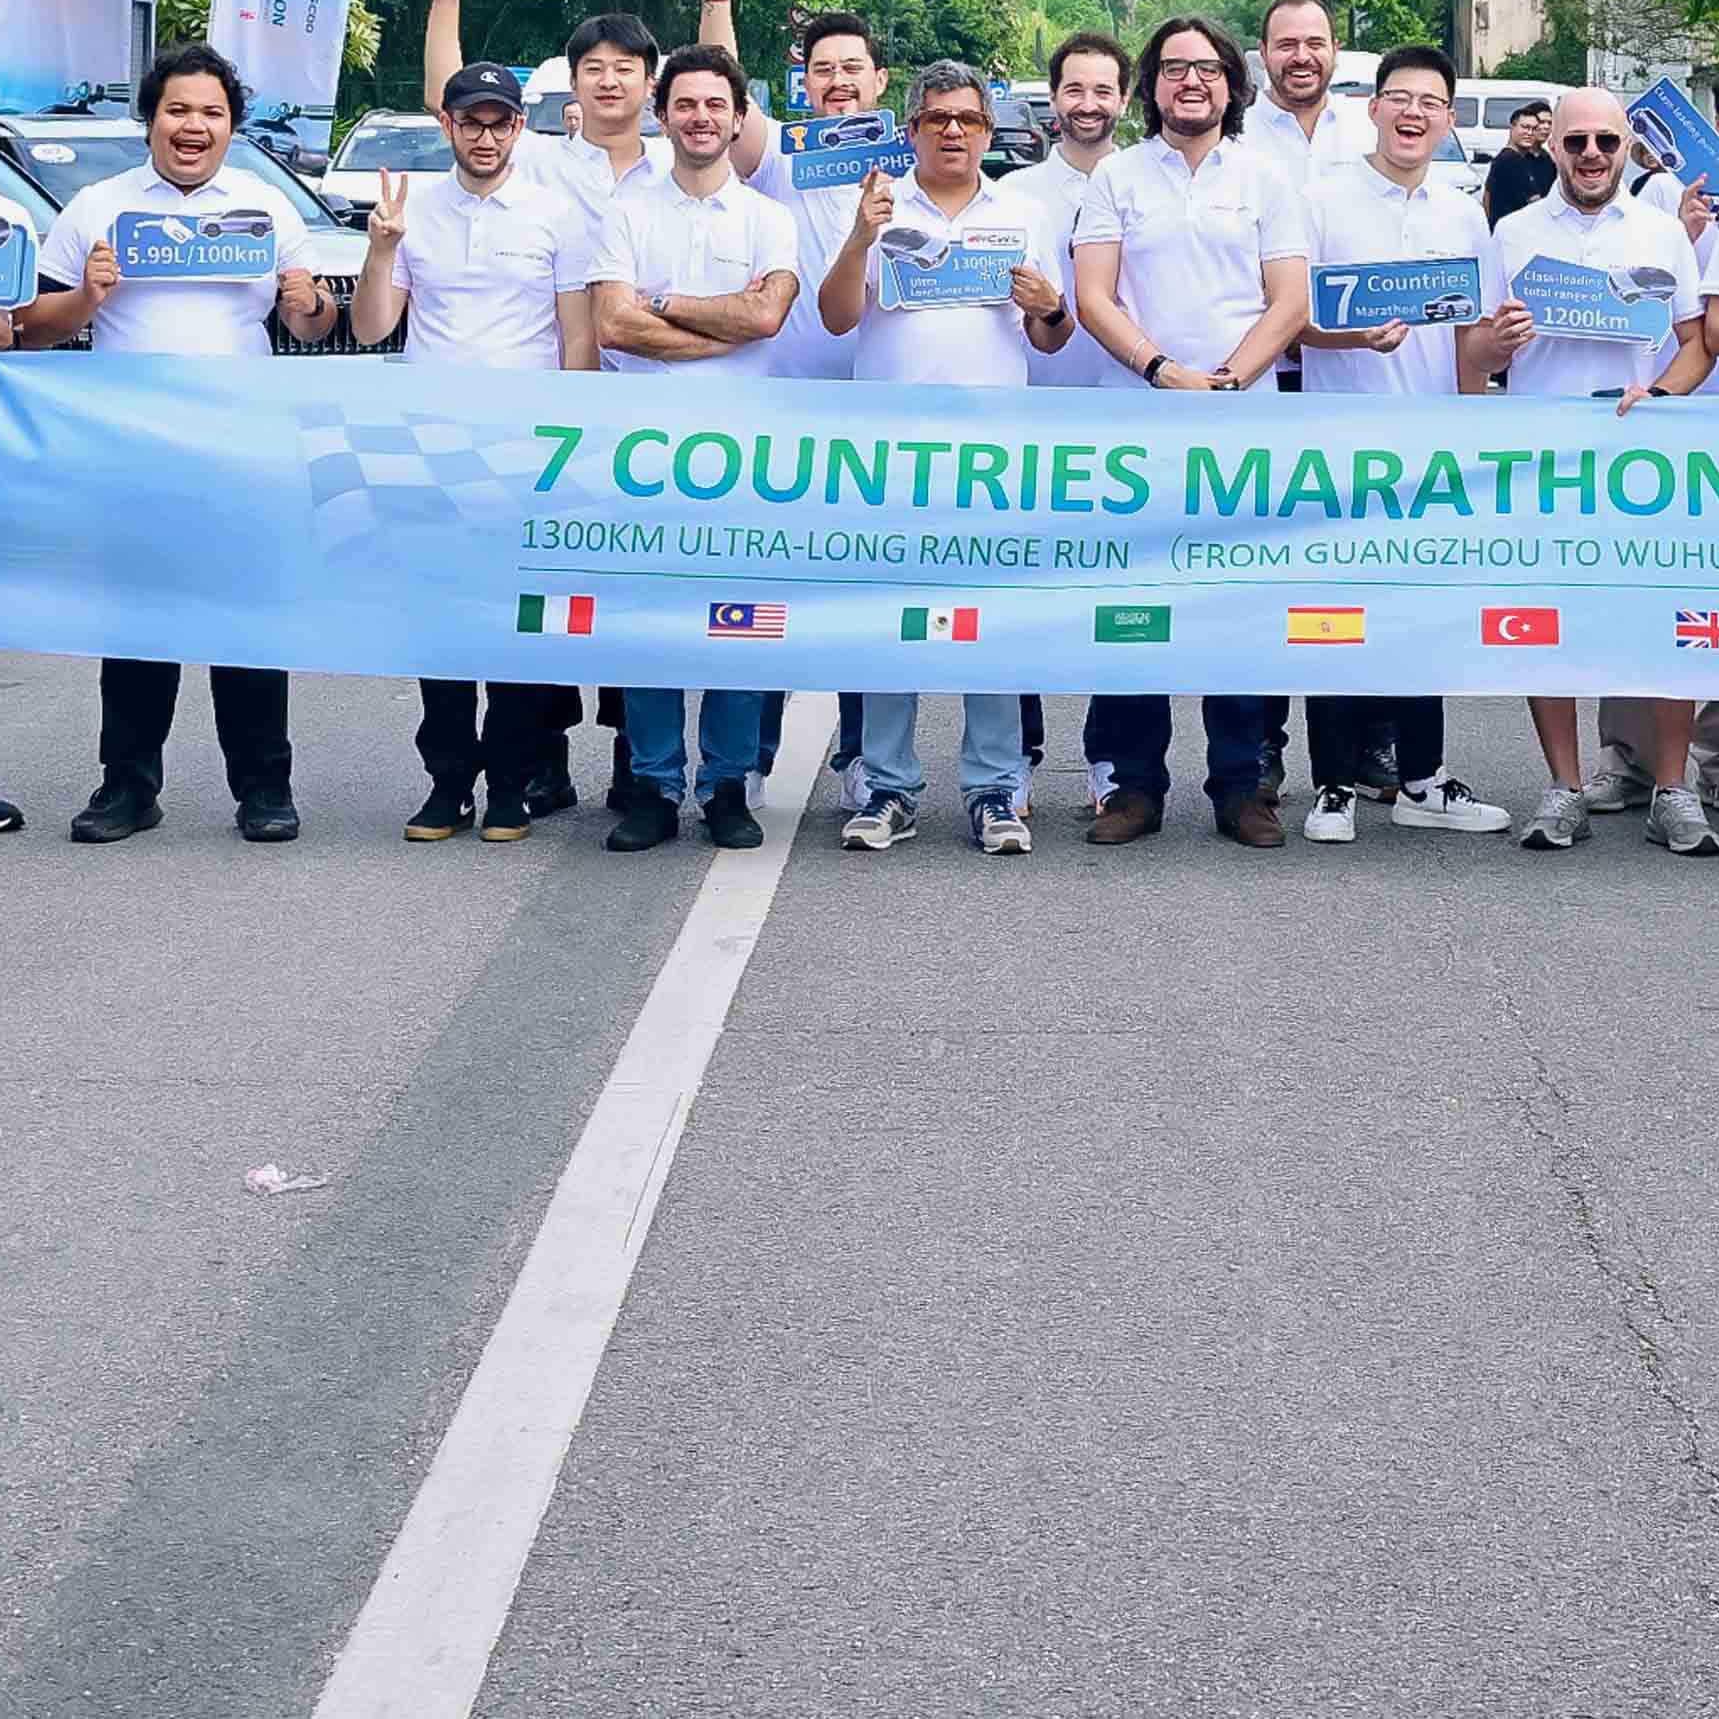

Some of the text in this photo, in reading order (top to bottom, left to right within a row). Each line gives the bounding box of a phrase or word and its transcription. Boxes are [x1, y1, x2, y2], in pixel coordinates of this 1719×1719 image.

[797, 160, 861, 181] JAECOO
[127, 245, 269, 267] 5.99L/100km
[1523, 269, 1604, 288] Class-leading
[1325, 270, 1470, 326] 7 Countries
[1523, 287, 1604, 304] total range of
[1355, 303, 1418, 317] Marathon
[1542, 305, 1630, 329] 1200km
[532, 424, 584, 492] 7
[611, 427, 1152, 515] COUNTRIES
[520, 518, 665, 555] 1300KM
[677, 524, 908, 567] ULTRA-LONG
[918, 530, 1042, 570] RANGE
[1054, 538, 1131, 570] RUN
[1303, 536, 1541, 569] GUANGZHOU
[1551, 538, 1601, 567] TO
